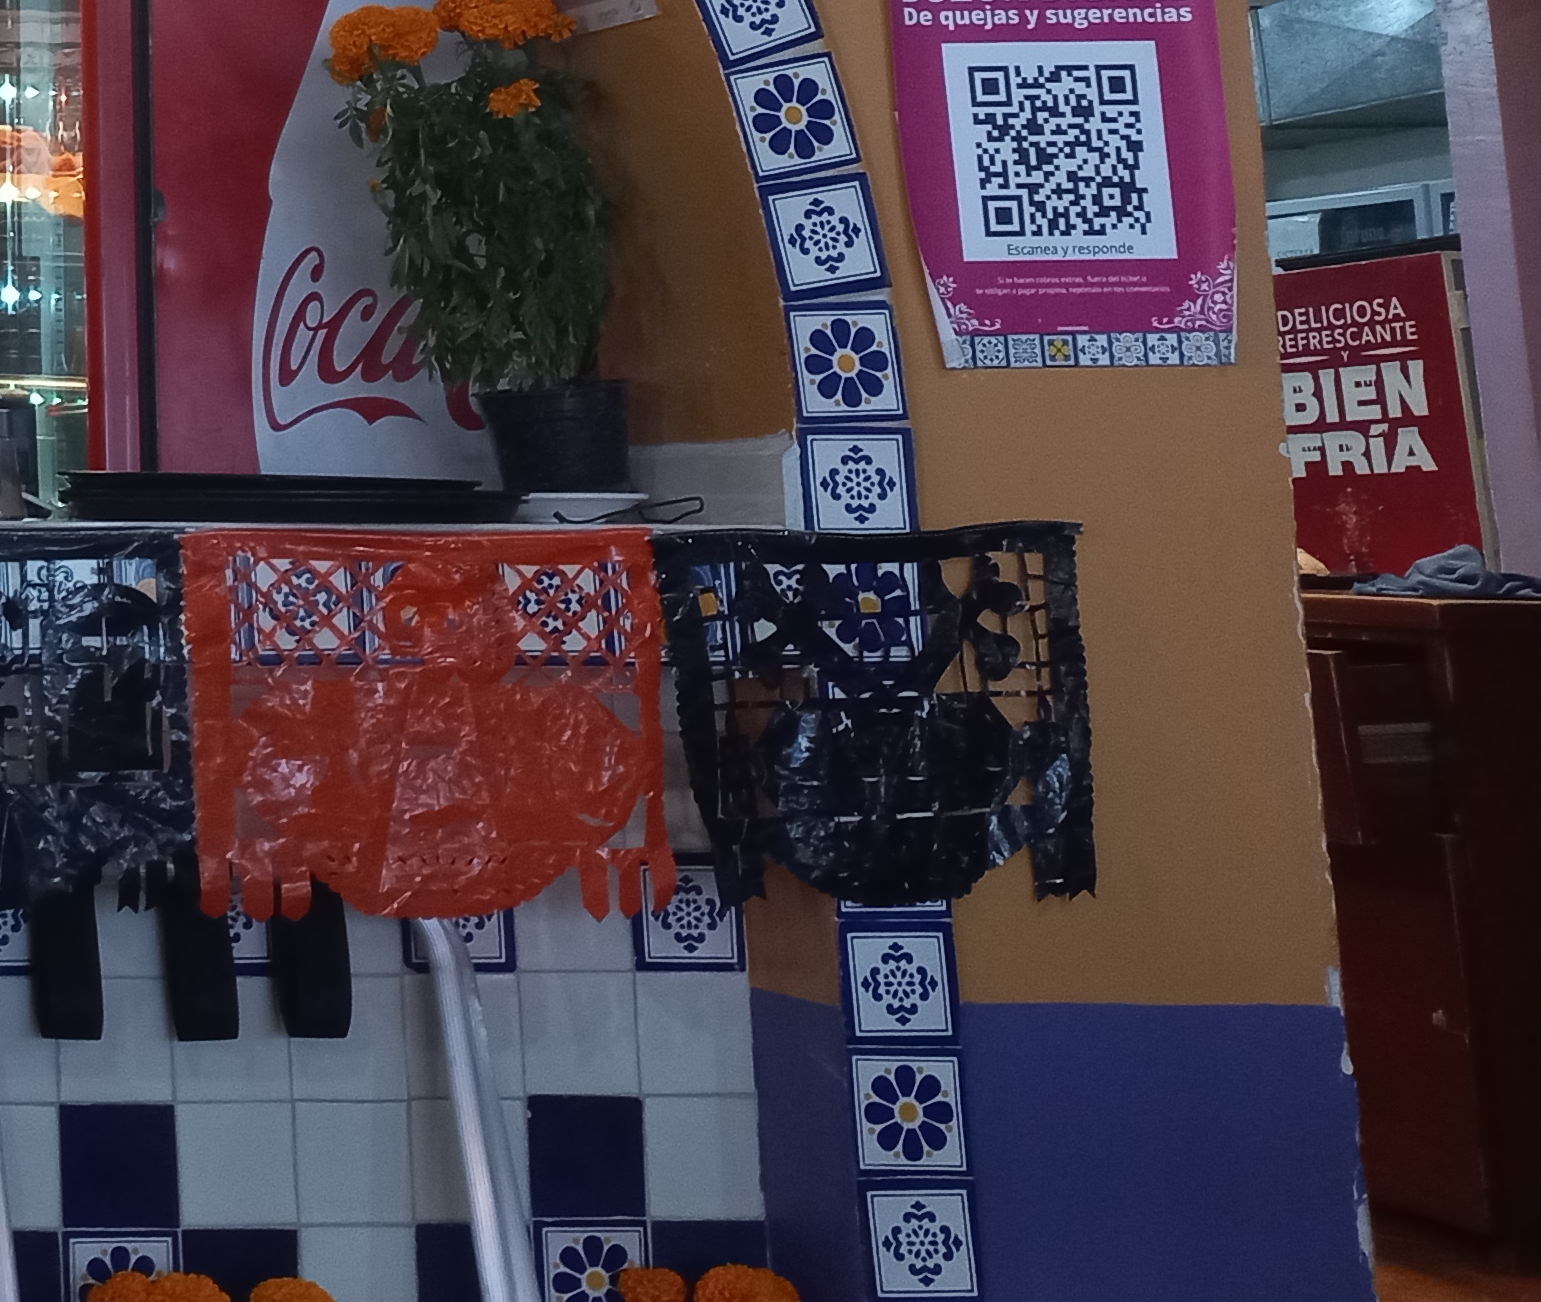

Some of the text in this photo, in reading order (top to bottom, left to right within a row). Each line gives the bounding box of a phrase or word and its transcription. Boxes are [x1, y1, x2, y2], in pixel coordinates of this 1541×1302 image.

[903, 3, 1193, 31] De quejas y sugerencias
[1006, 241, 1134, 259] Escanea y responde
[1277, 296, 1407, 332] DELICIOSA
[1340, 350, 1350, 363] Y
[1281, 359, 1429, 427] BIEN
[1287, 422, 1438, 479] FRÍA
